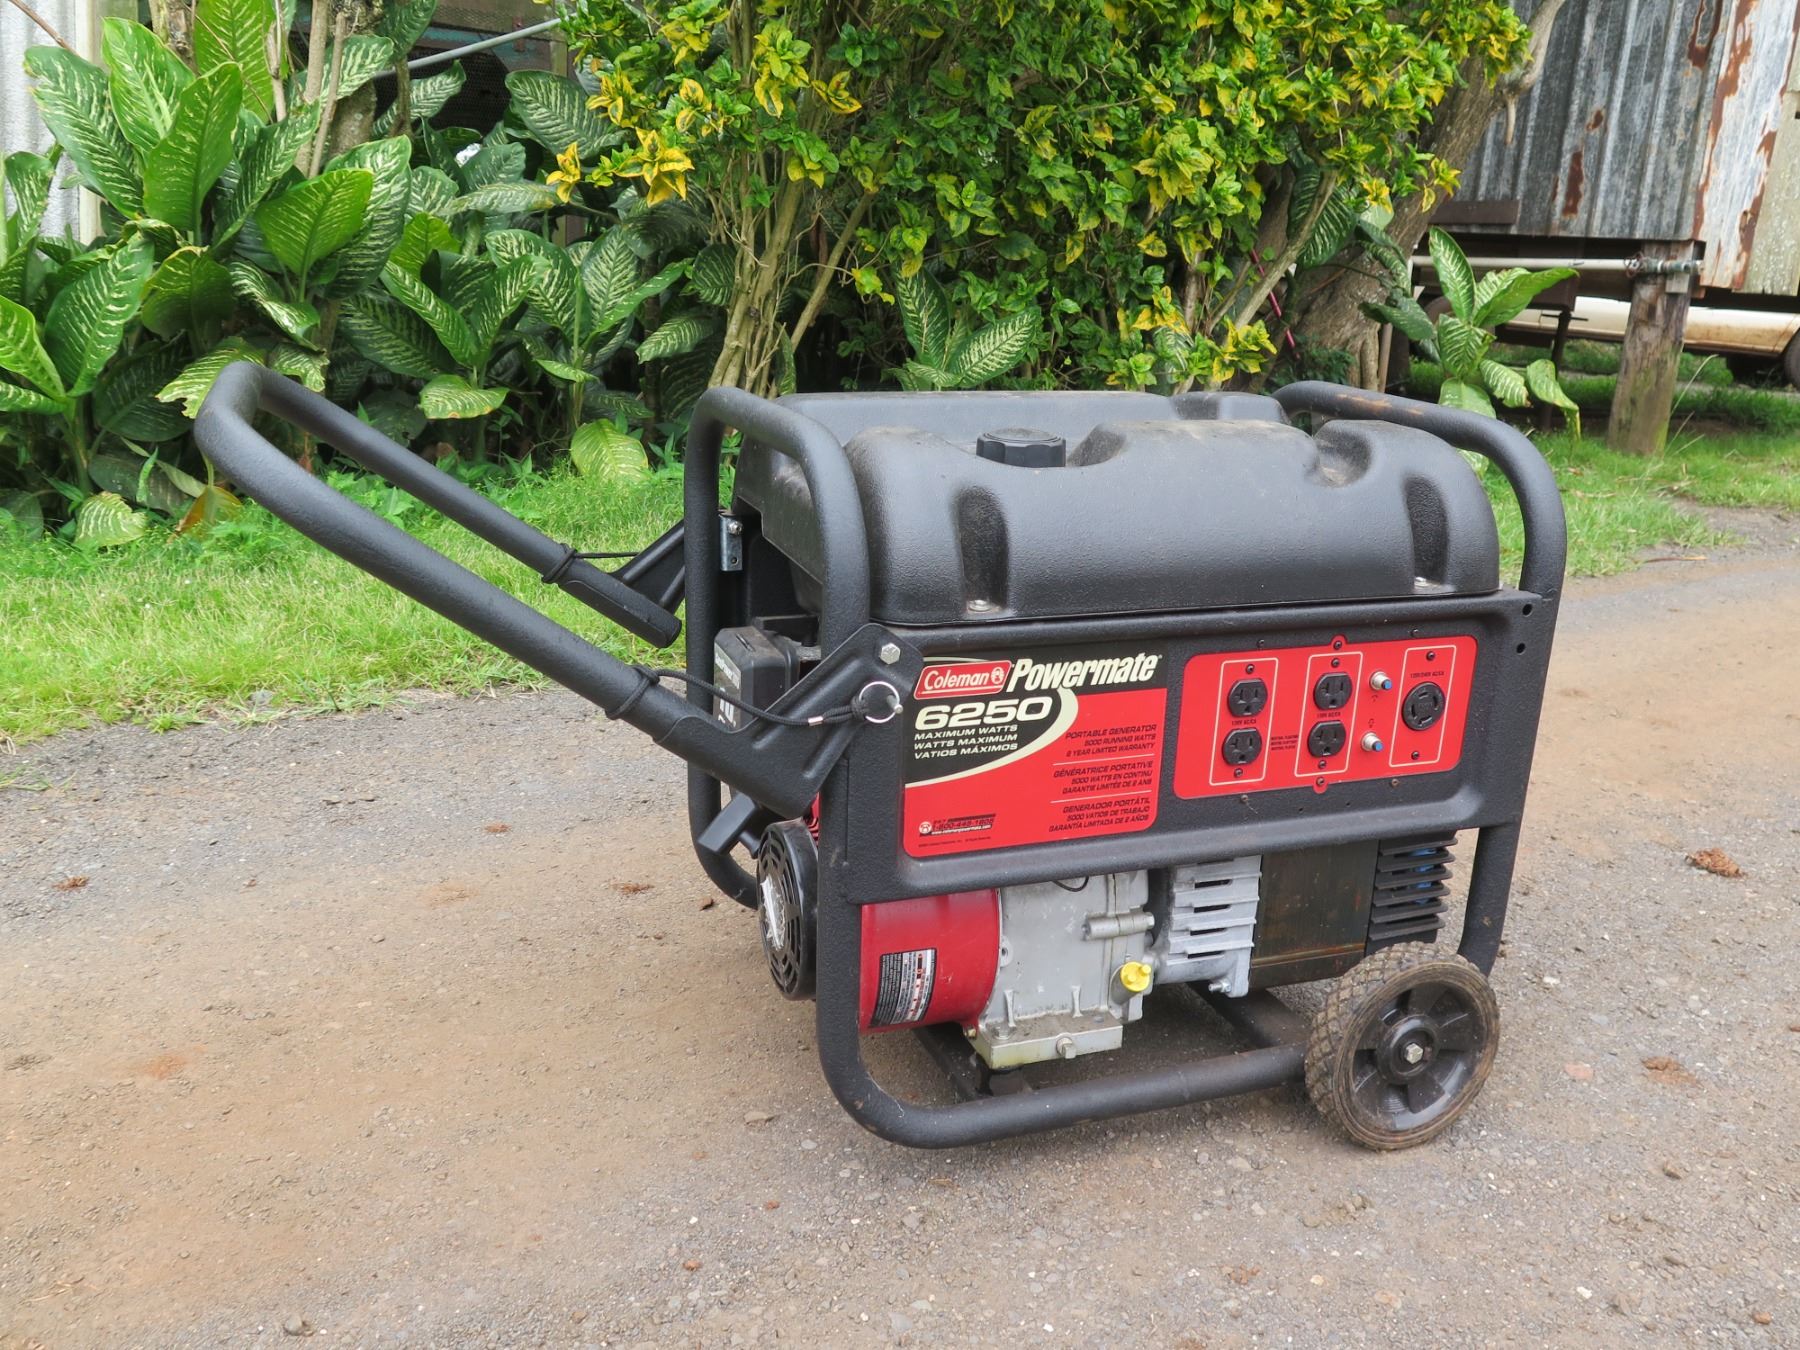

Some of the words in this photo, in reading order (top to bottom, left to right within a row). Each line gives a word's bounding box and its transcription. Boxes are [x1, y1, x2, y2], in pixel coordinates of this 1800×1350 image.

[924, 670, 990, 690] Coleman
[1006, 652, 1159, 692] Powermate
[914, 696, 1053, 731] 6250
[914, 728, 976, 740] MAXIMUM
[978, 724, 1018, 734] WATTS
[1066, 729, 1107, 739] PORTABLE
[1109, 724, 1157, 735] GENERATOR
[914, 740, 955, 750] WATTS
[958, 734, 1018, 746] MAXIMUM
[1103, 736, 1133, 746] RUNNING
[1134, 734, 1156, 742] WATTS
[914, 749, 958, 760] VATIOS
[960, 743, 1018, 755] MÁXIMOS
[1073, 748, 1090, 756] YEAR
[1092, 746, 1116, 754] LIMITED
[1119, 742, 1155, 752] WARRANTY
[1054, 766, 1108, 778] GÉNÉRATRICE
[1110, 760, 1153, 771] PORTATIVE
[1090, 774, 1112, 782] WATTS
[1124, 770, 1152, 779] CONTINU
[1062, 784, 1096, 794] GARANTIE
[1062, 802, 1112, 814] GENERADOR
[1086, 812, 1108, 820] VATIOS
[1120, 806, 1150, 815] TRABAJO
[1084, 818, 1114, 828] LIMITADA
